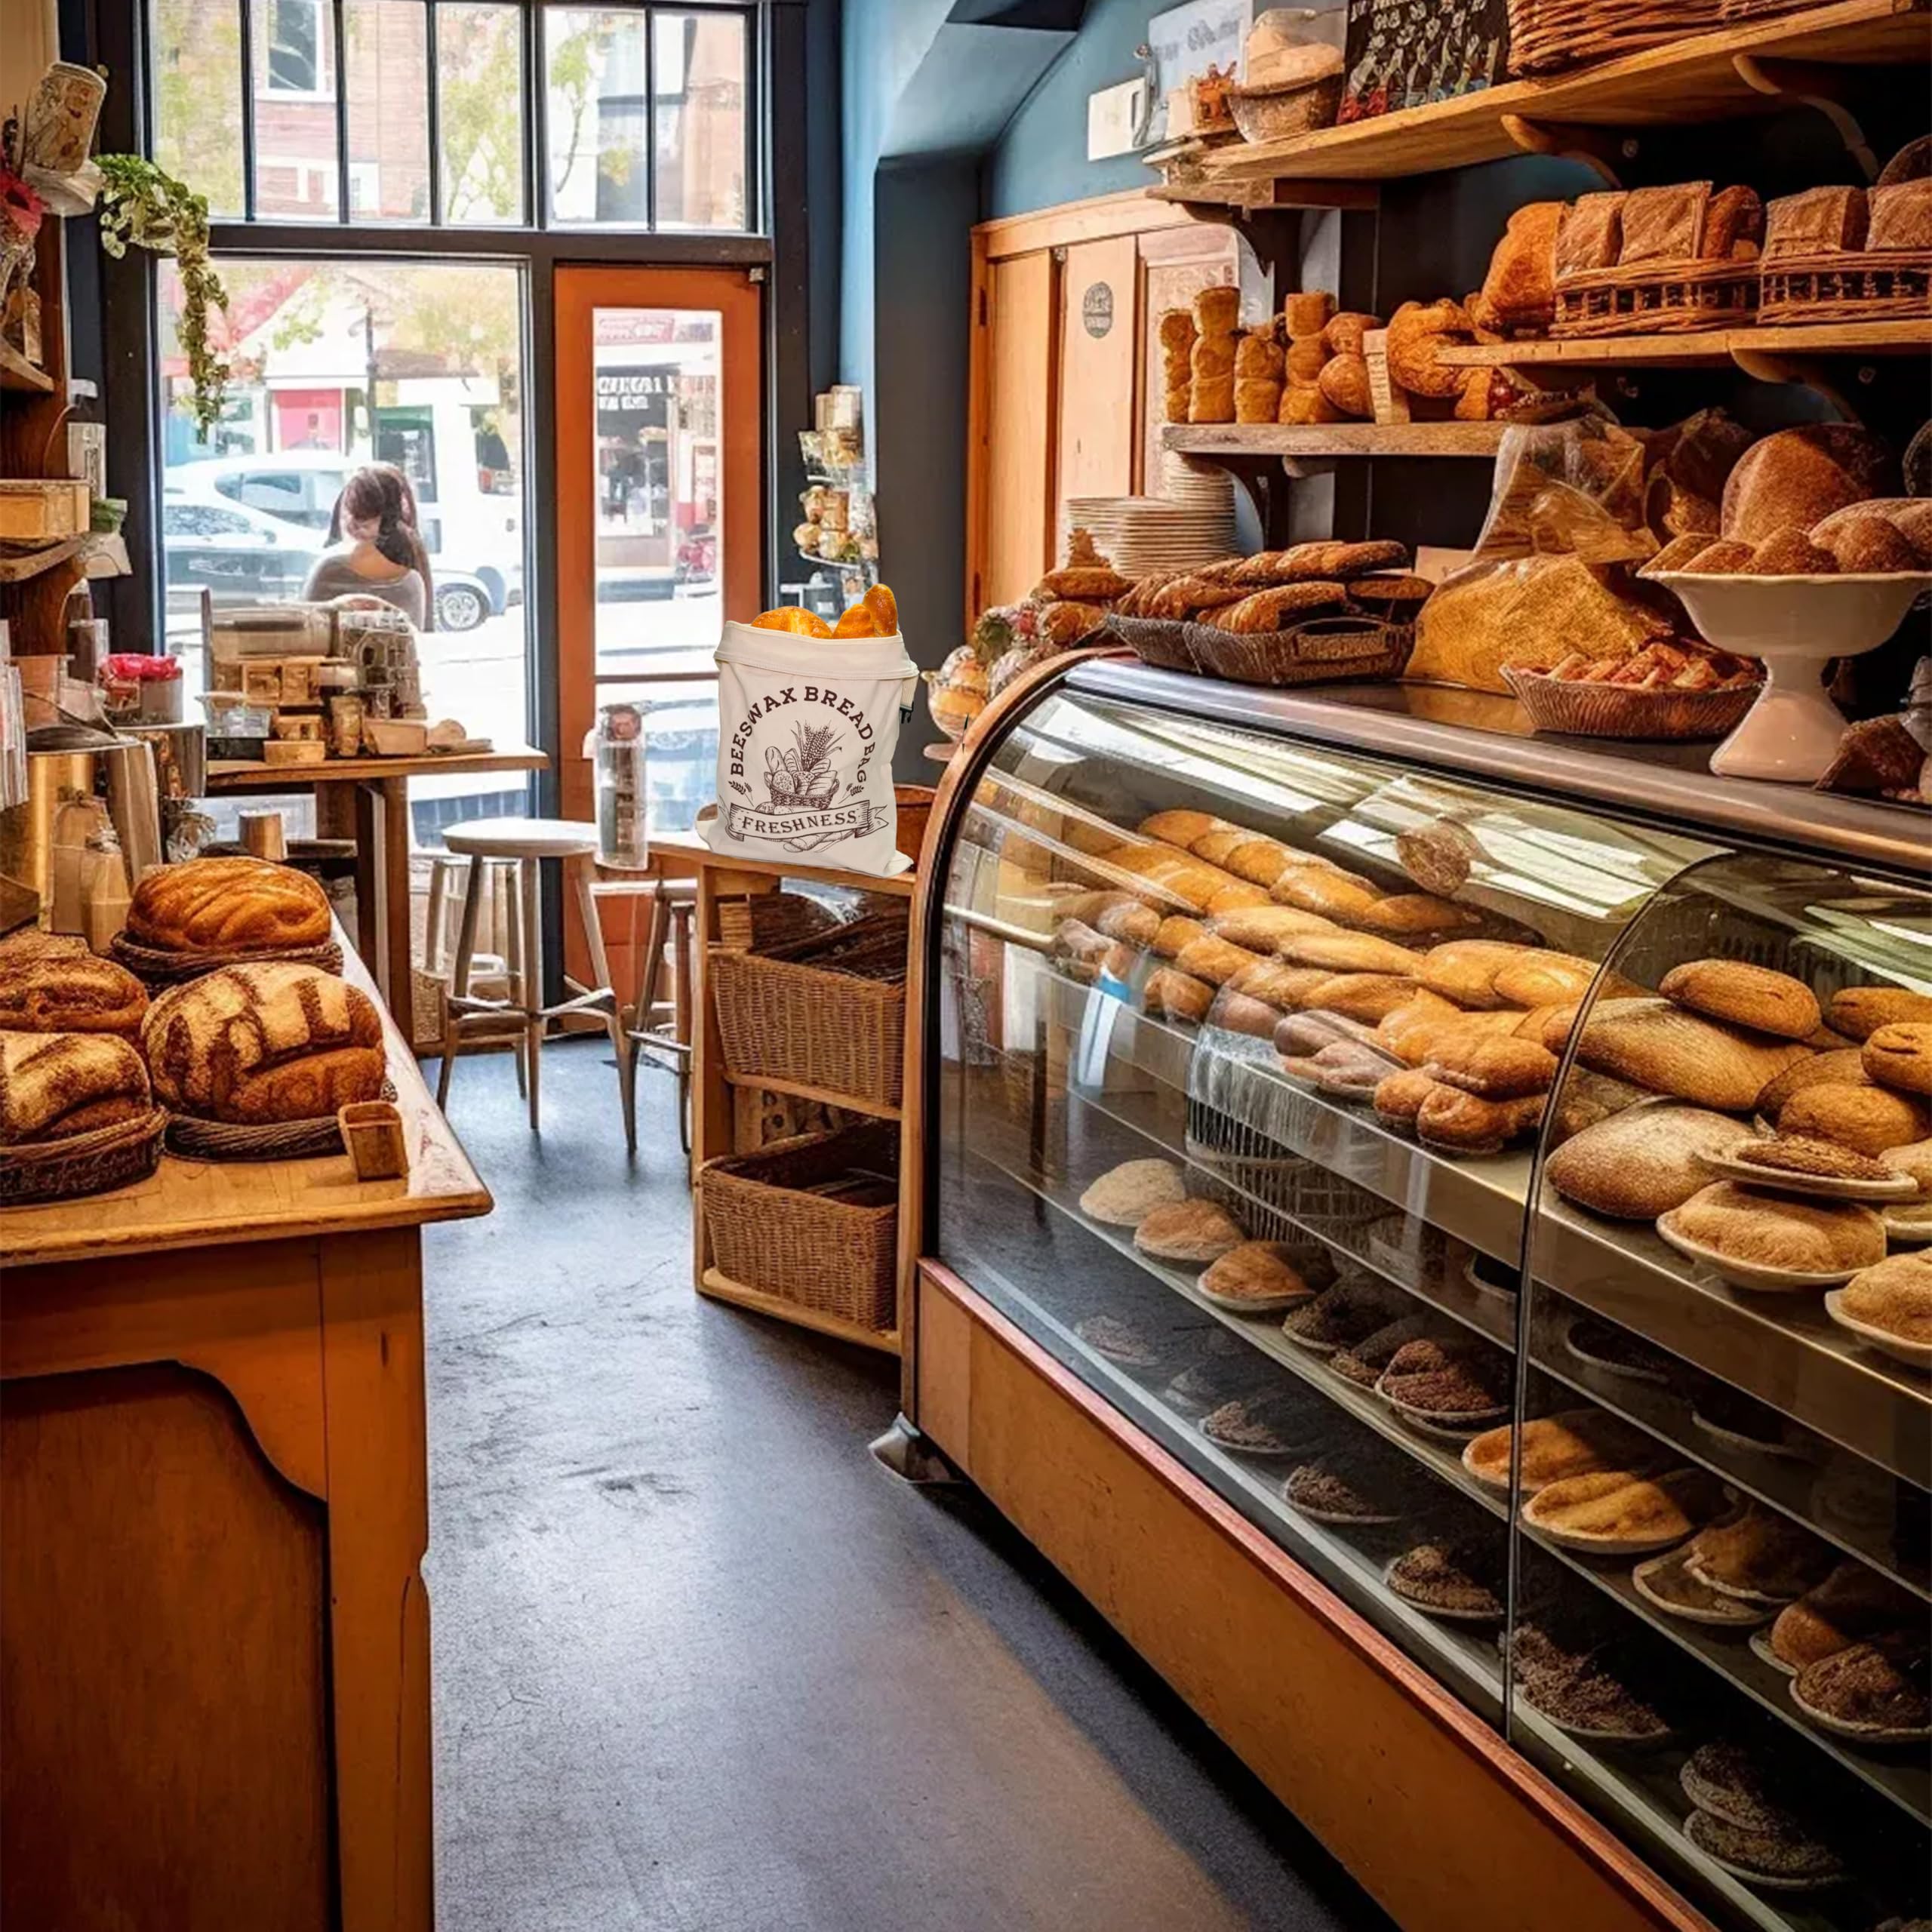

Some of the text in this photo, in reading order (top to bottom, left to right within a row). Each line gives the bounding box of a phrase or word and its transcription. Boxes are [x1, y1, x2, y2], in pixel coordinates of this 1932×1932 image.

[731, 686, 876, 783] BEESWAX BREAD BAG
[742, 811, 857, 834] FRESHNESS
